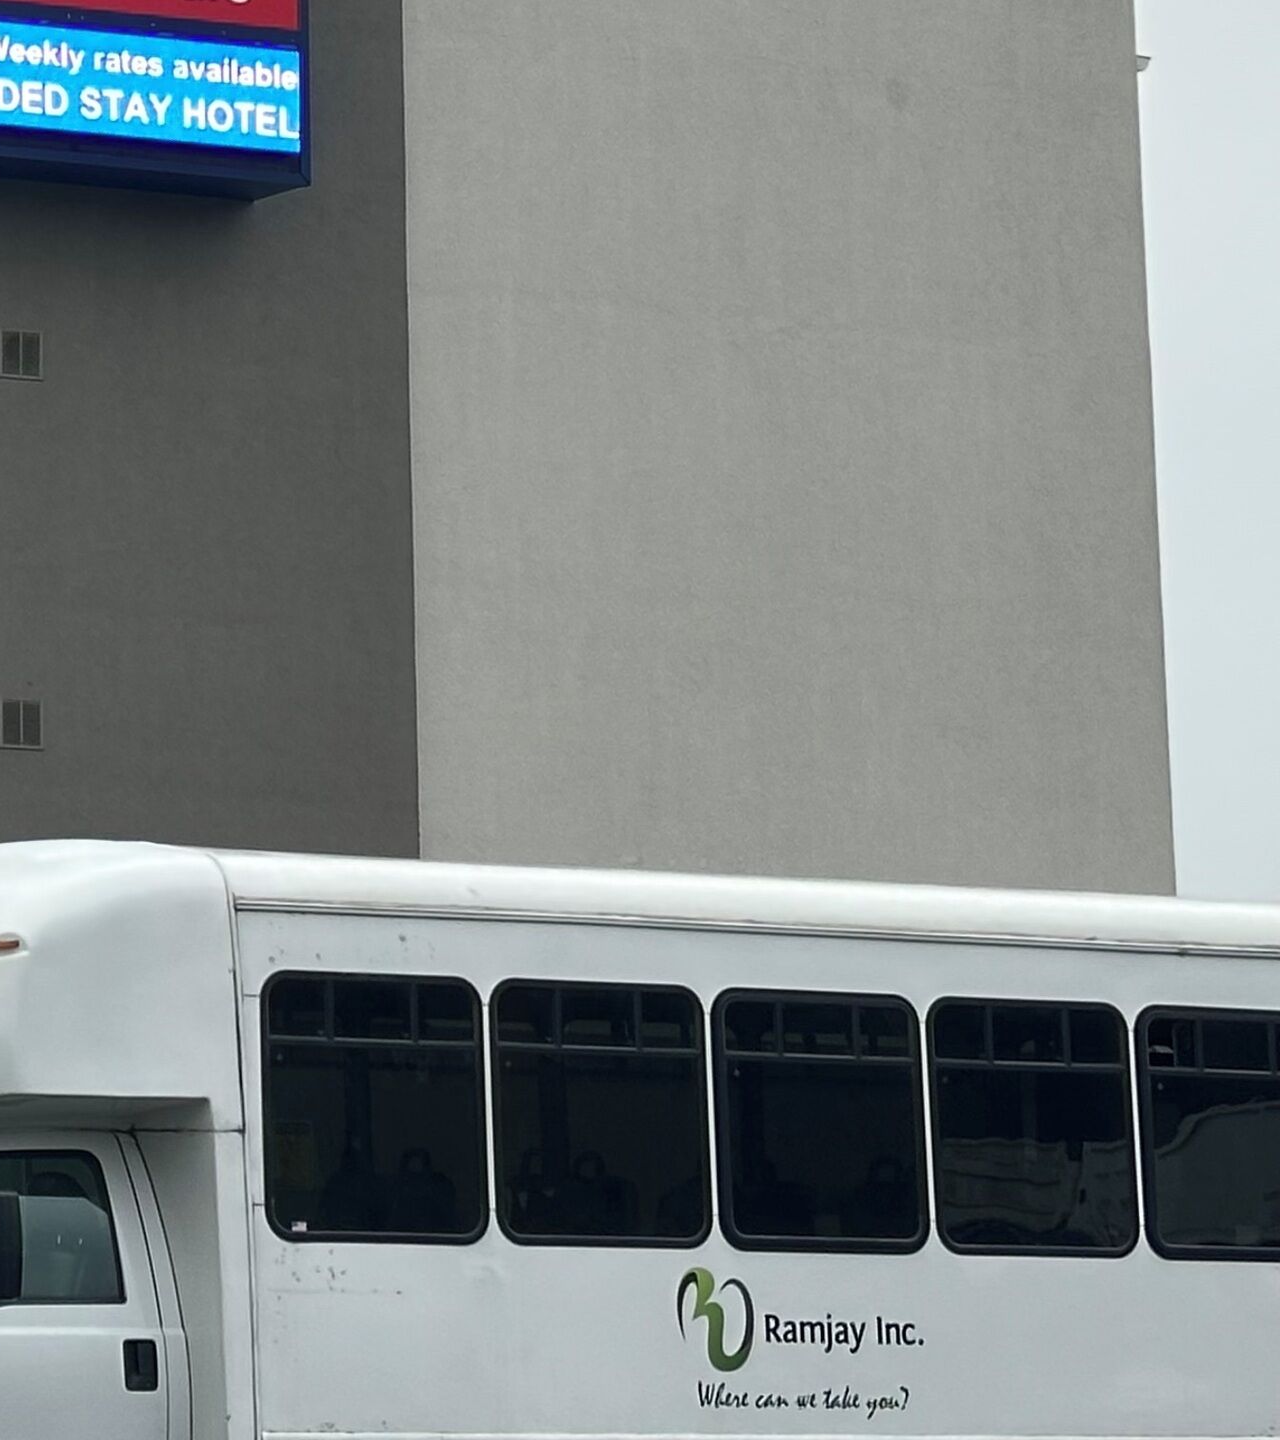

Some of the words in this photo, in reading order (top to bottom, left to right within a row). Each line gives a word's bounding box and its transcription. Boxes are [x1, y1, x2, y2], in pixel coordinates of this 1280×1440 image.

[93, 50, 164, 78] rates
[172, 57, 300, 91] available
[79, 87, 173, 126] STAY
[182, 97, 300, 139] HOTEL
[764, 1313, 866, 1353] Ramjay
[876, 1316, 925, 1346] Inc.
[698, 1380, 749, 1408] Where
[755, 1392, 789, 1408] can
[797, 1392, 818, 1408] we
[823, 1386, 860, 1409] take
[867, 1386, 909, 1420] you?
